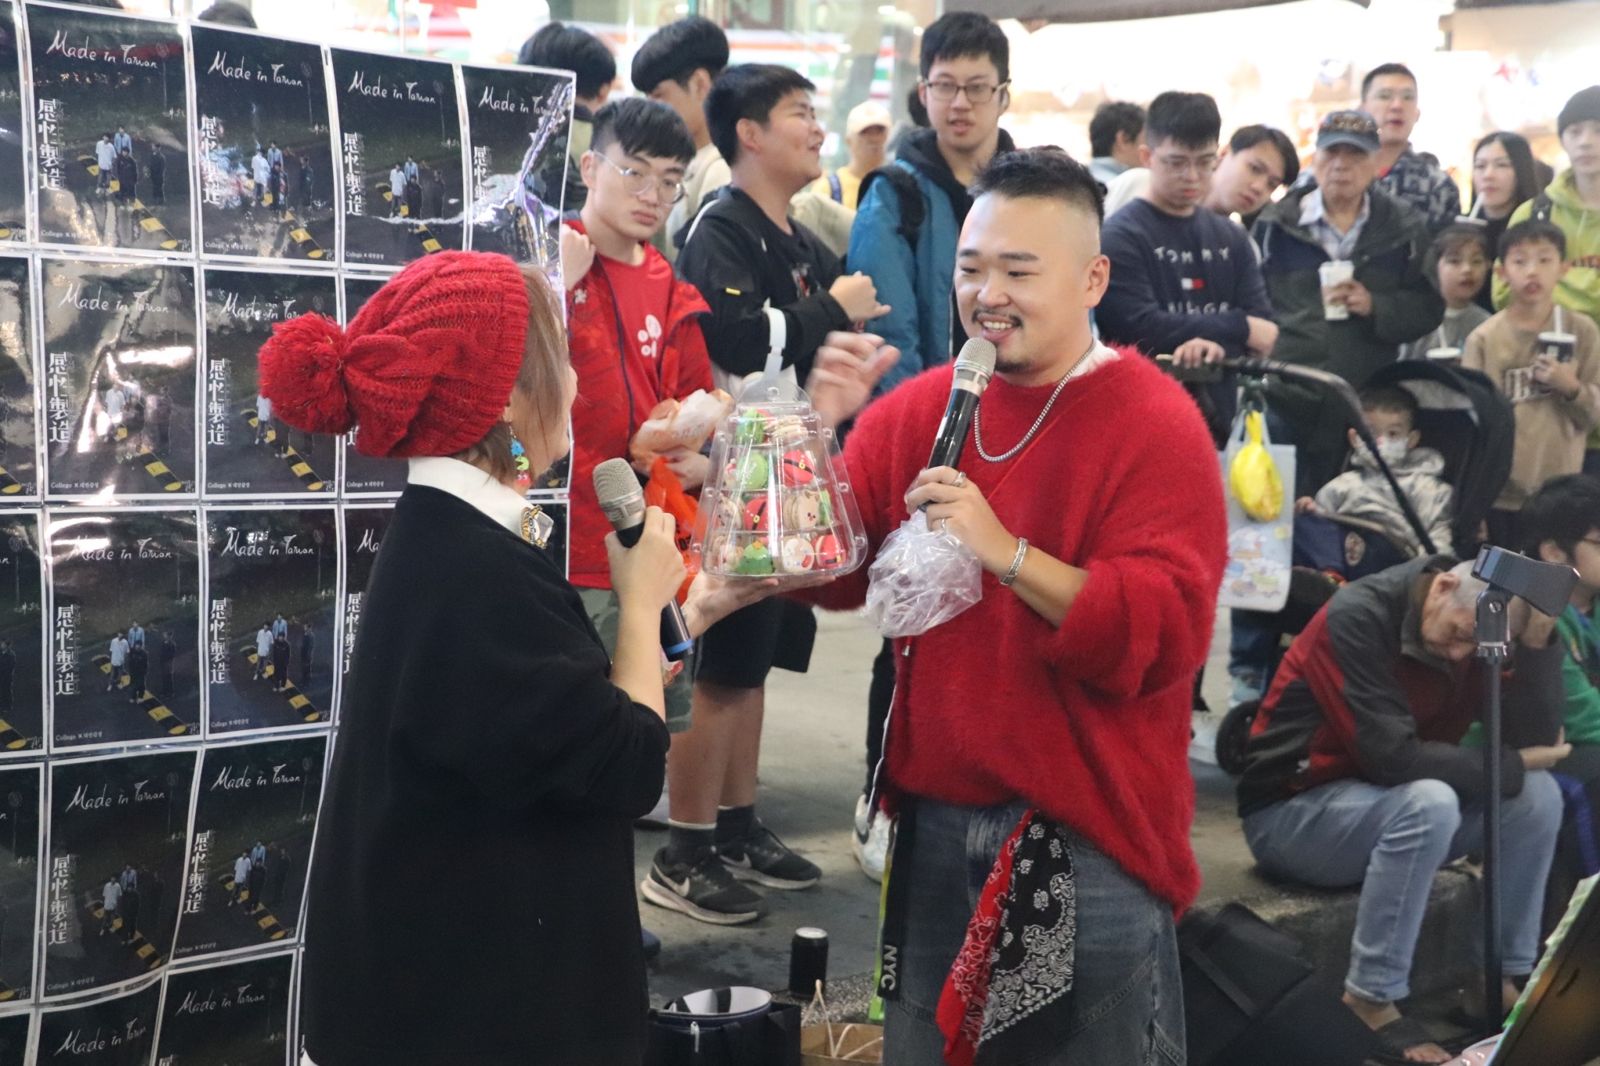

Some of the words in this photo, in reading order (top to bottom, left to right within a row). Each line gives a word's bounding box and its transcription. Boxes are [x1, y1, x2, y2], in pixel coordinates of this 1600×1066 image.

[46, 30, 97, 61] Made
[103, 50, 117, 63] in
[208, 50, 251, 78] Made
[257, 64, 267, 82] in
[348, 70, 387, 98] Made
[393, 82, 403, 100] in
[478, 86, 515, 111] Made
[520, 98, 529, 113] in
[1154, 246, 1230, 263] TOMMY
[58, 283, 109, 310] Made
[116, 300, 128, 312] in
[220, 291, 260, 320] Made
[67, 536, 114, 561] Made
[120, 549, 132, 559] in
[138, 538, 173, 559] Taiwan
[221, 530, 263, 557] Made
[269, 544, 279, 555] in
[210, 765, 252, 791] Made
[256, 772, 267, 786] in
[65, 783, 112, 812] Made
[118, 791, 129, 804] in
[880, 945, 897, 991] NYC
[174, 990, 217, 1016] Made
[221, 995, 232, 1008] in
[53, 1027, 106, 1057] Made
[111, 1034, 122, 1047] in
